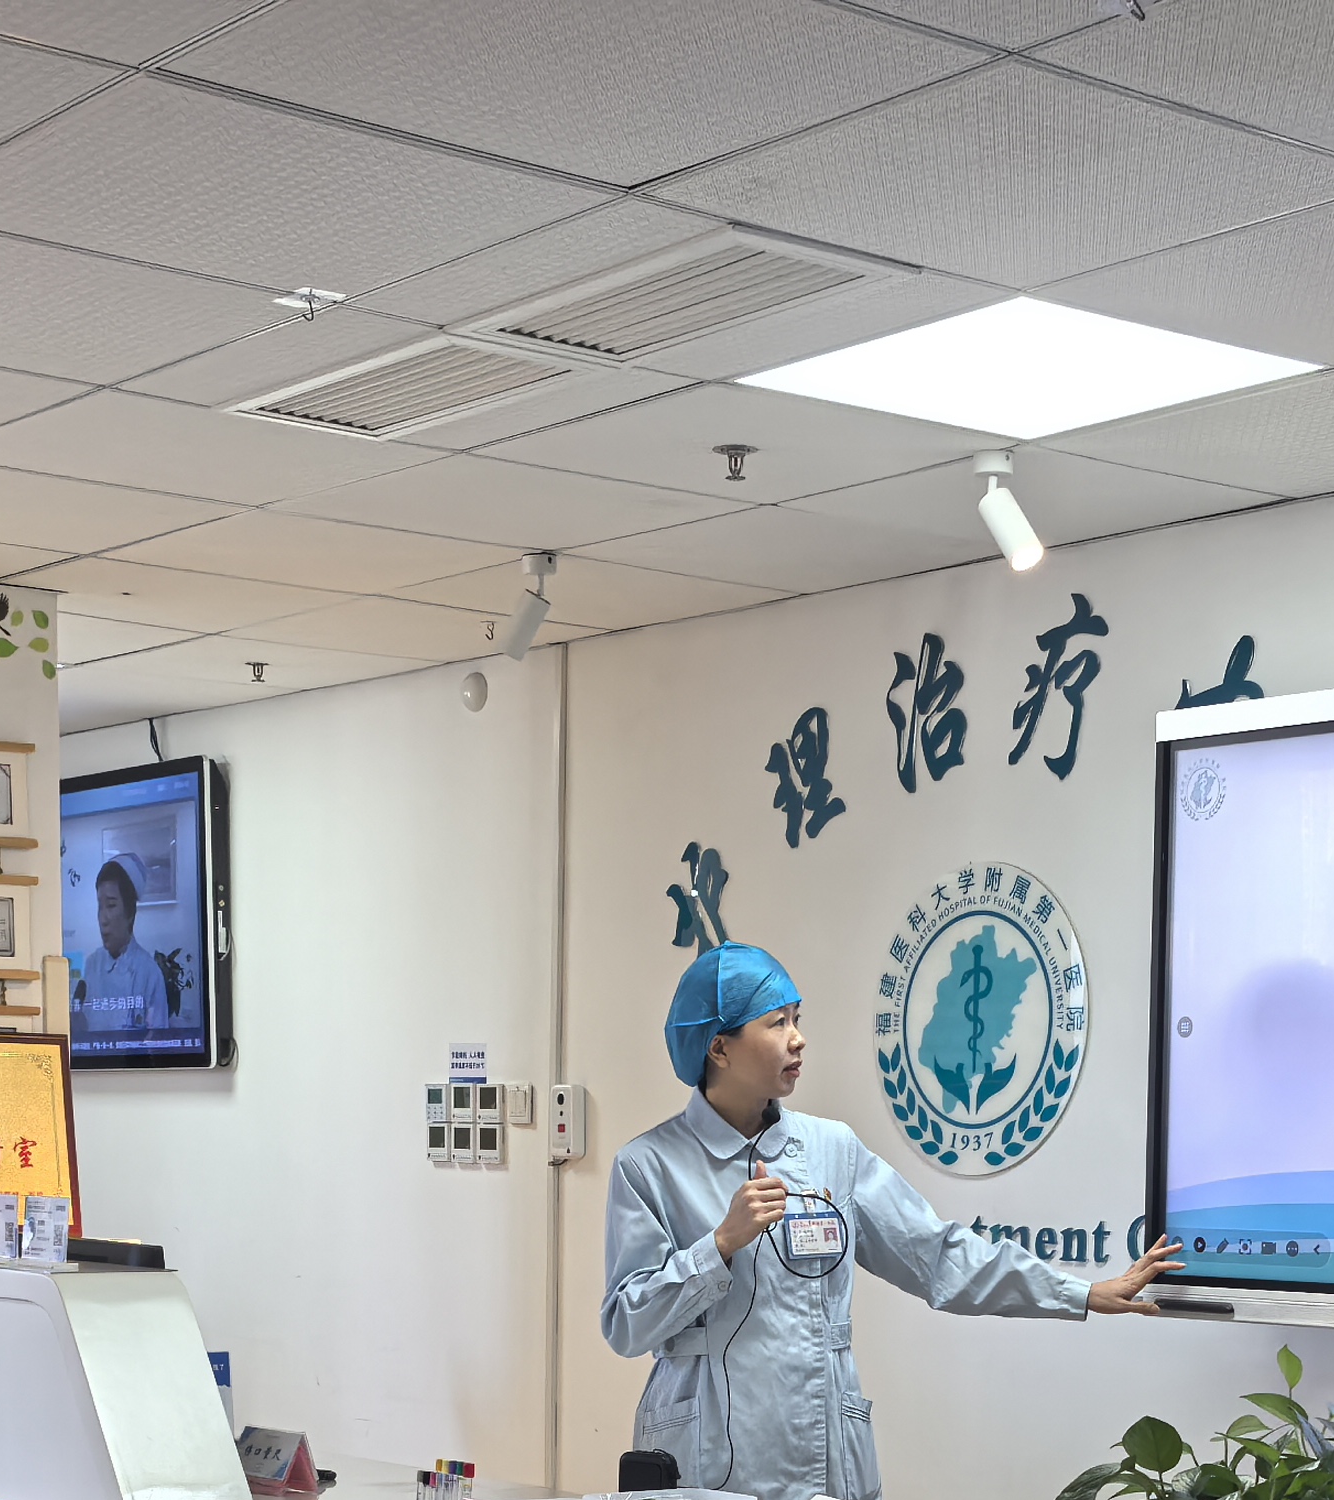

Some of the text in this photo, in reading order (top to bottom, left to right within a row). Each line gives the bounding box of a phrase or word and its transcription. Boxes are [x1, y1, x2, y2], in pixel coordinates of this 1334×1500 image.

[875, 866, 1086, 1037] 福建医科大学附属第一医院
[894, 975, 907, 1009] FIRST
[903, 919, 938, 974] AFFILIATED
[938, 896, 978, 924] HOSPITAL
[979, 895, 992, 906] OF
[992, 895, 1024, 917] FUJIAN
[1022, 912, 1053, 957] MEDICAL
[1048, 955, 1065, 1030] UNIVERSITY
[950, 1131, 995, 1151] 1937
